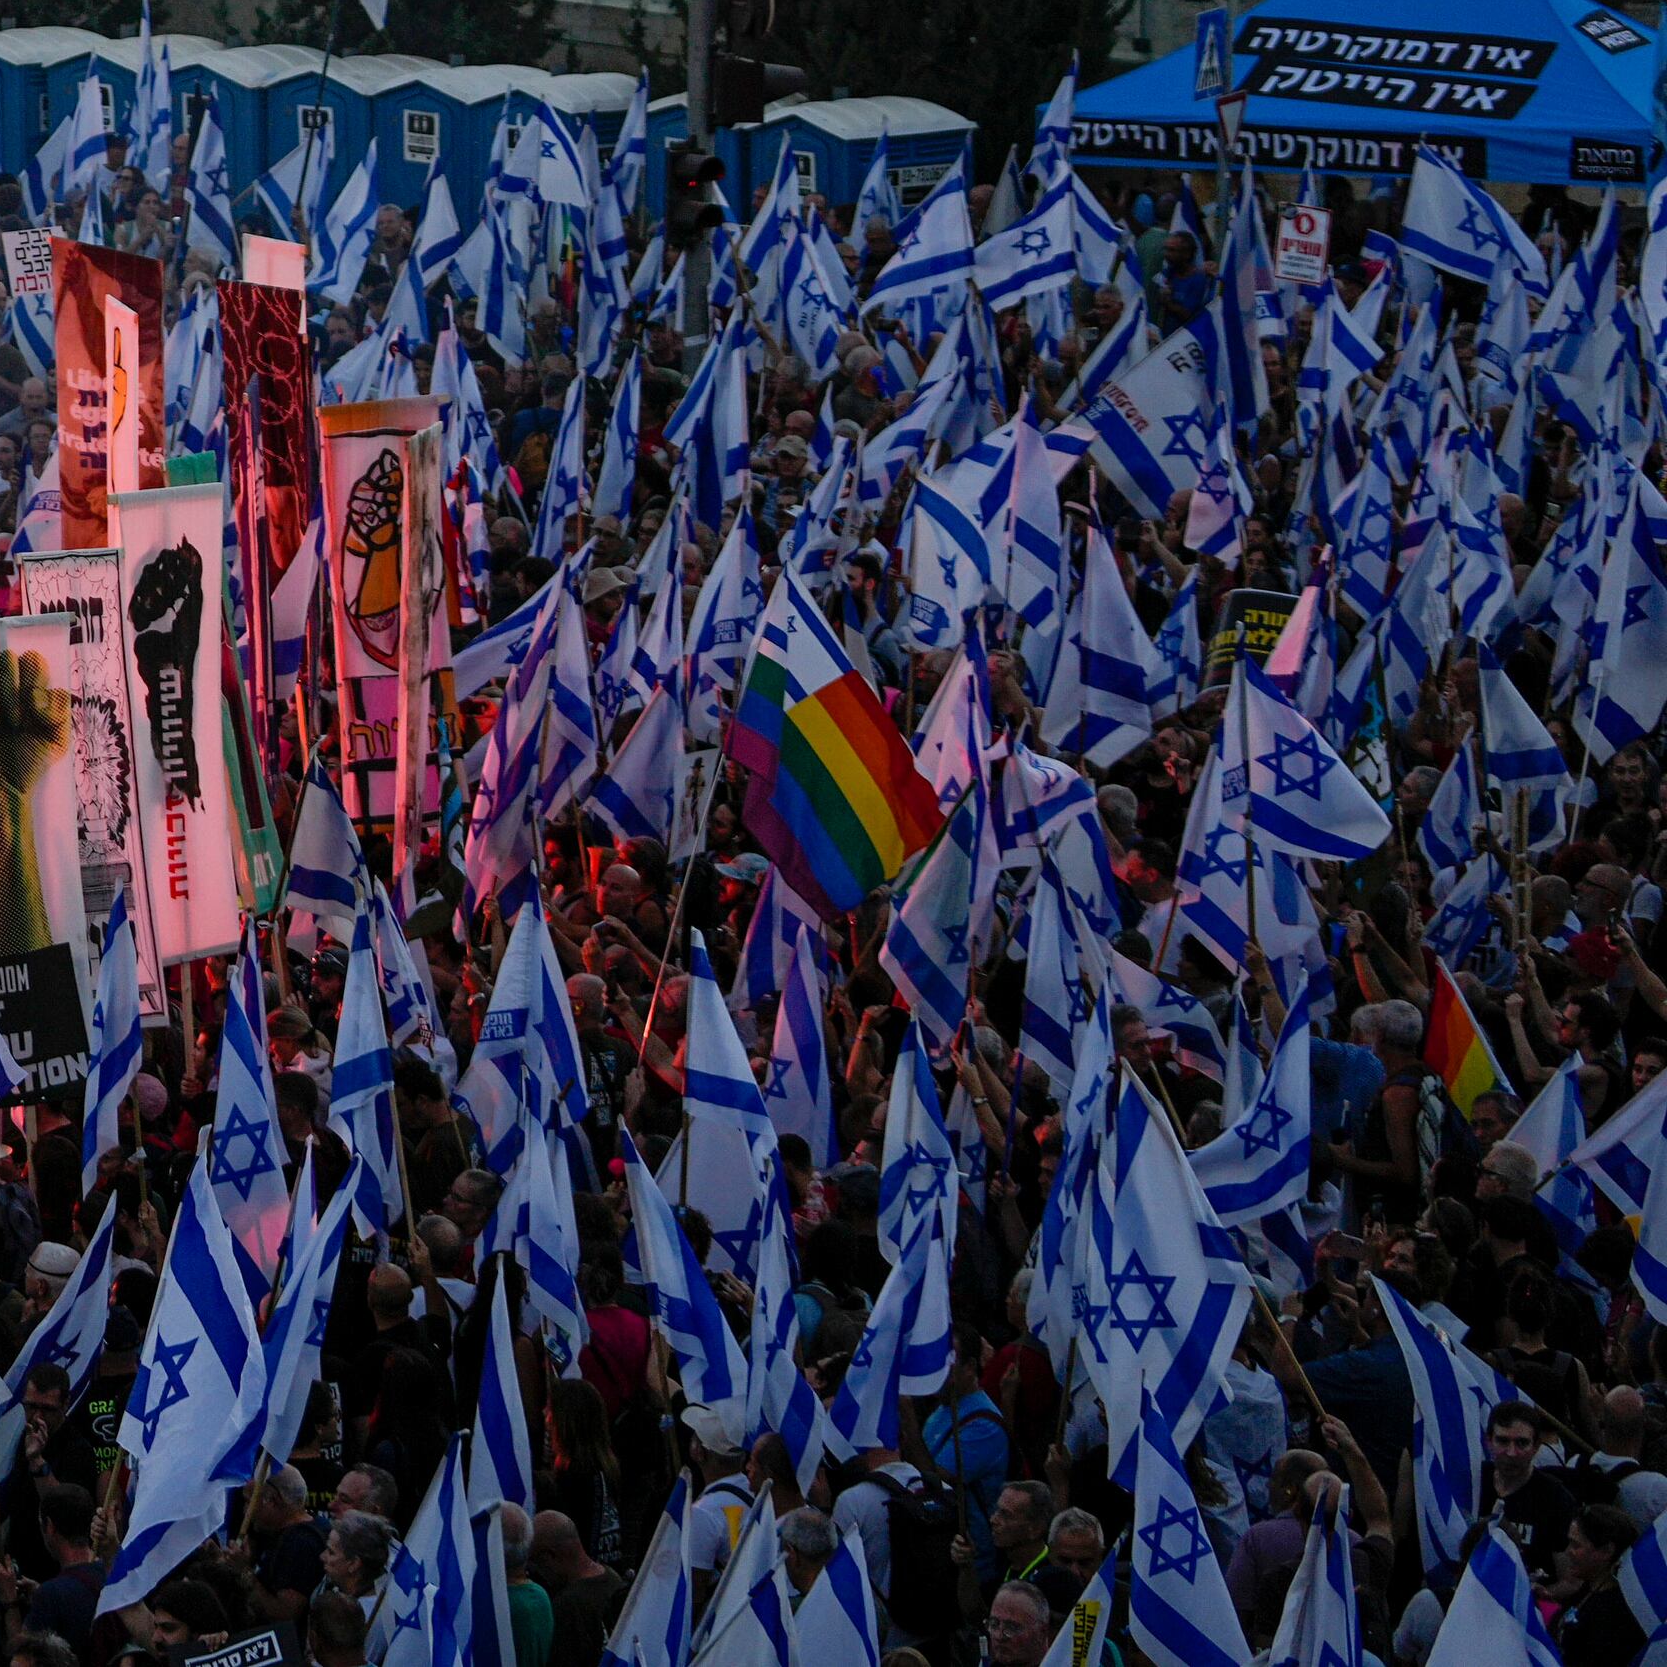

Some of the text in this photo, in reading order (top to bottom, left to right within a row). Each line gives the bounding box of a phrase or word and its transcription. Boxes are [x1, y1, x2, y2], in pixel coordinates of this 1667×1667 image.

[1248, 25, 1534, 73] אין דמוקרטיה
[1258, 63, 1508, 112] אין הייטק
[1070, 119, 1166, 152] הייטק
[1237, 130, 1404, 168] דמוקרטיה
[1578, 147, 1636, 165] מחאת
[246, 1638, 269, 1662] לא
